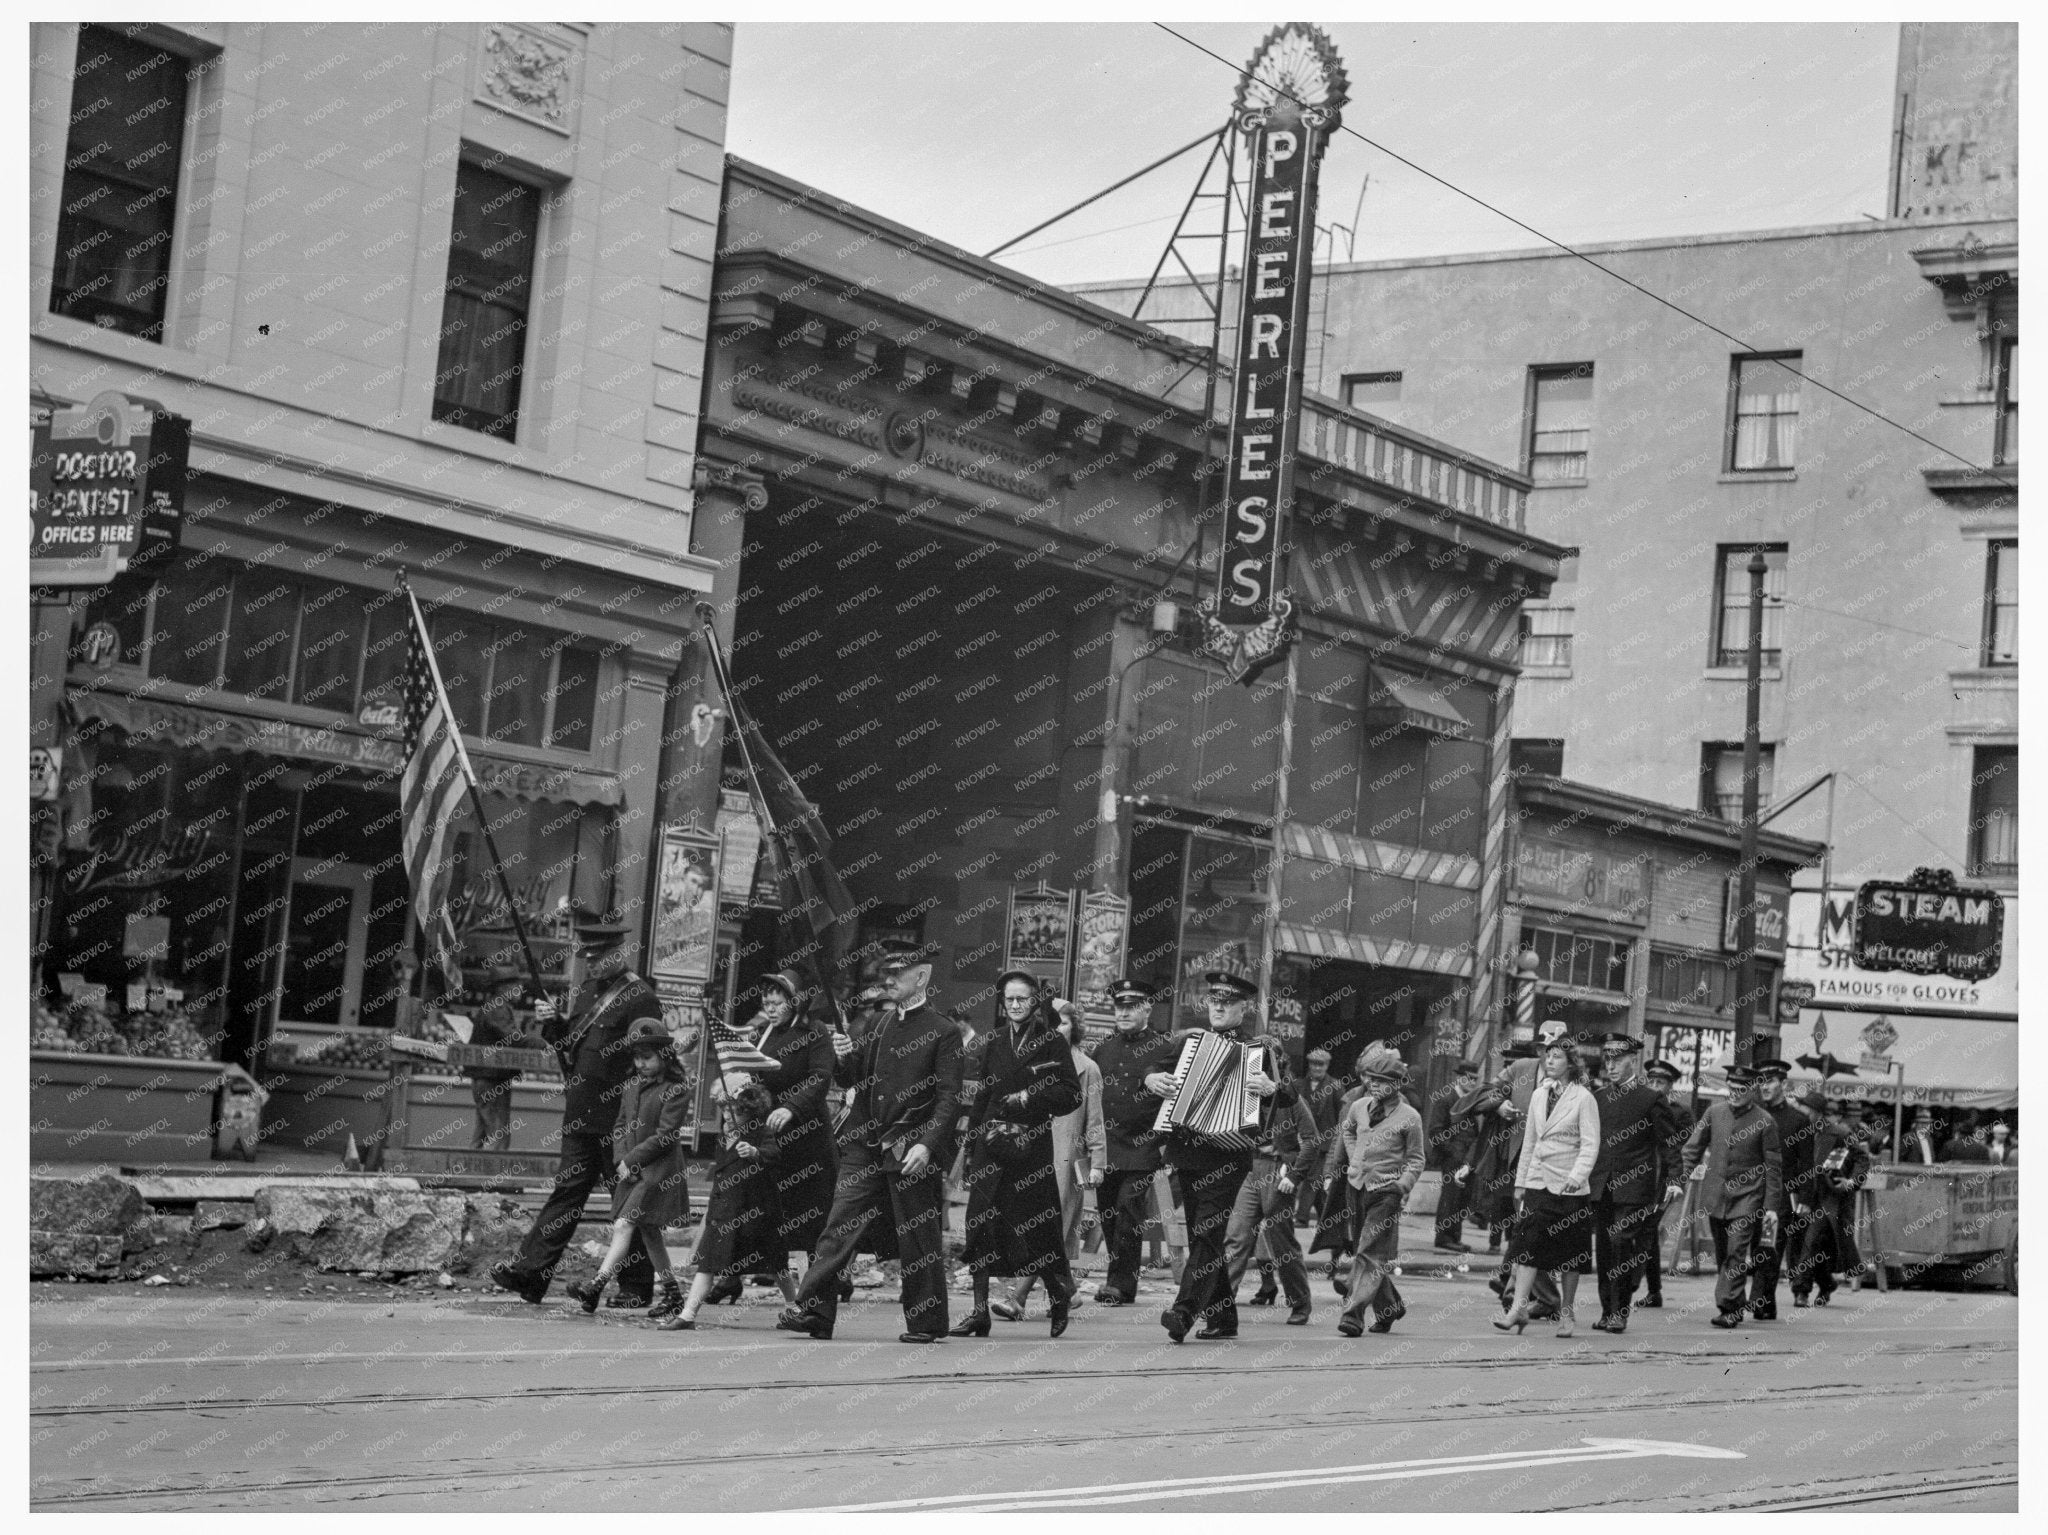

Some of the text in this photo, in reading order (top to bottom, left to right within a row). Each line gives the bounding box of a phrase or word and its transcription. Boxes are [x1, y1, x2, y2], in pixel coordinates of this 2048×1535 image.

[1229, 131, 1297, 607] PEERLESS
[54, 450, 137, 481] DOCTOR
[51, 488, 134, 517] DENTIST
[42, 526, 95, 544] OFFICES
[100, 525, 134, 543] HERE
[1872, 890, 1990, 925] STEAM
[1185, 953, 1252, 979] MAJESTIC
[1819, 950, 1850, 969] SH
[1864, 945, 1939, 966] WELCOME
[1179, 991, 1209, 1007] LUNC
[1819, 979, 1882, 996] FAMOUS
[1887, 985, 1909, 995] FOR
[1913, 986, 1980, 1002] GLOVES
[1275, 998, 1303, 1021] SHOE
[1914, 1087, 1955, 1102] MEN
